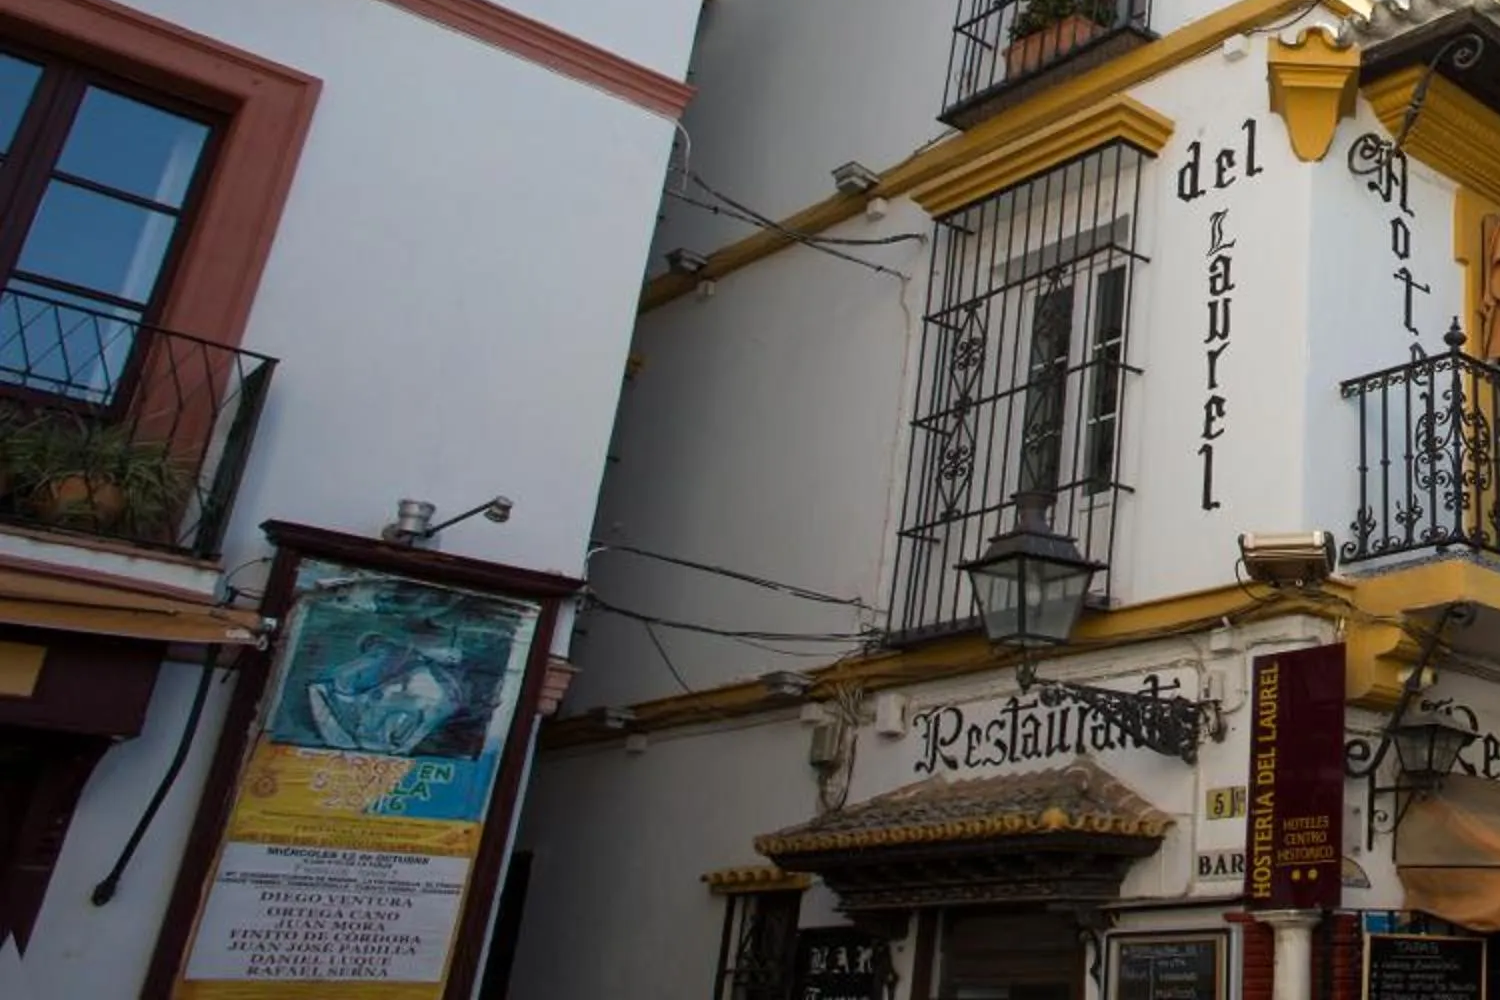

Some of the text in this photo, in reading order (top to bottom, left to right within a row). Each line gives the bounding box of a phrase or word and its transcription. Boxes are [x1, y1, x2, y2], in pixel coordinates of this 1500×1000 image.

[1176, 119, 1264, 202] del
[1197, 208, 1236, 512] Laurel
[1258, 661, 1279, 743] LAUREL
[913, 674, 1187, 774] Restaurant
[419, 762, 456, 784] EN
[1257, 746, 1276, 785] DEL
[1214, 792, 1224, 815] 5
[1283, 815, 1329, 831] HOTELES
[1284, 831, 1328, 846] CENTRO
[1198, 853, 1244, 876] BAR
[259, 891, 414, 909] DIEGO VENTURA
[266, 907, 401, 922] ORTEGA CANO
[274, 919, 386, 932] JUAN MORA
[230, 929, 299, 941] FINITO
[303, 930, 329, 942] DE
[227, 941, 281, 952] JUAN
[339, 943, 418, 956] PADILLA
[250, 953, 393, 968] DANIEL LUQUE
[246, 965, 389, 978] RAFAEL SERNA
